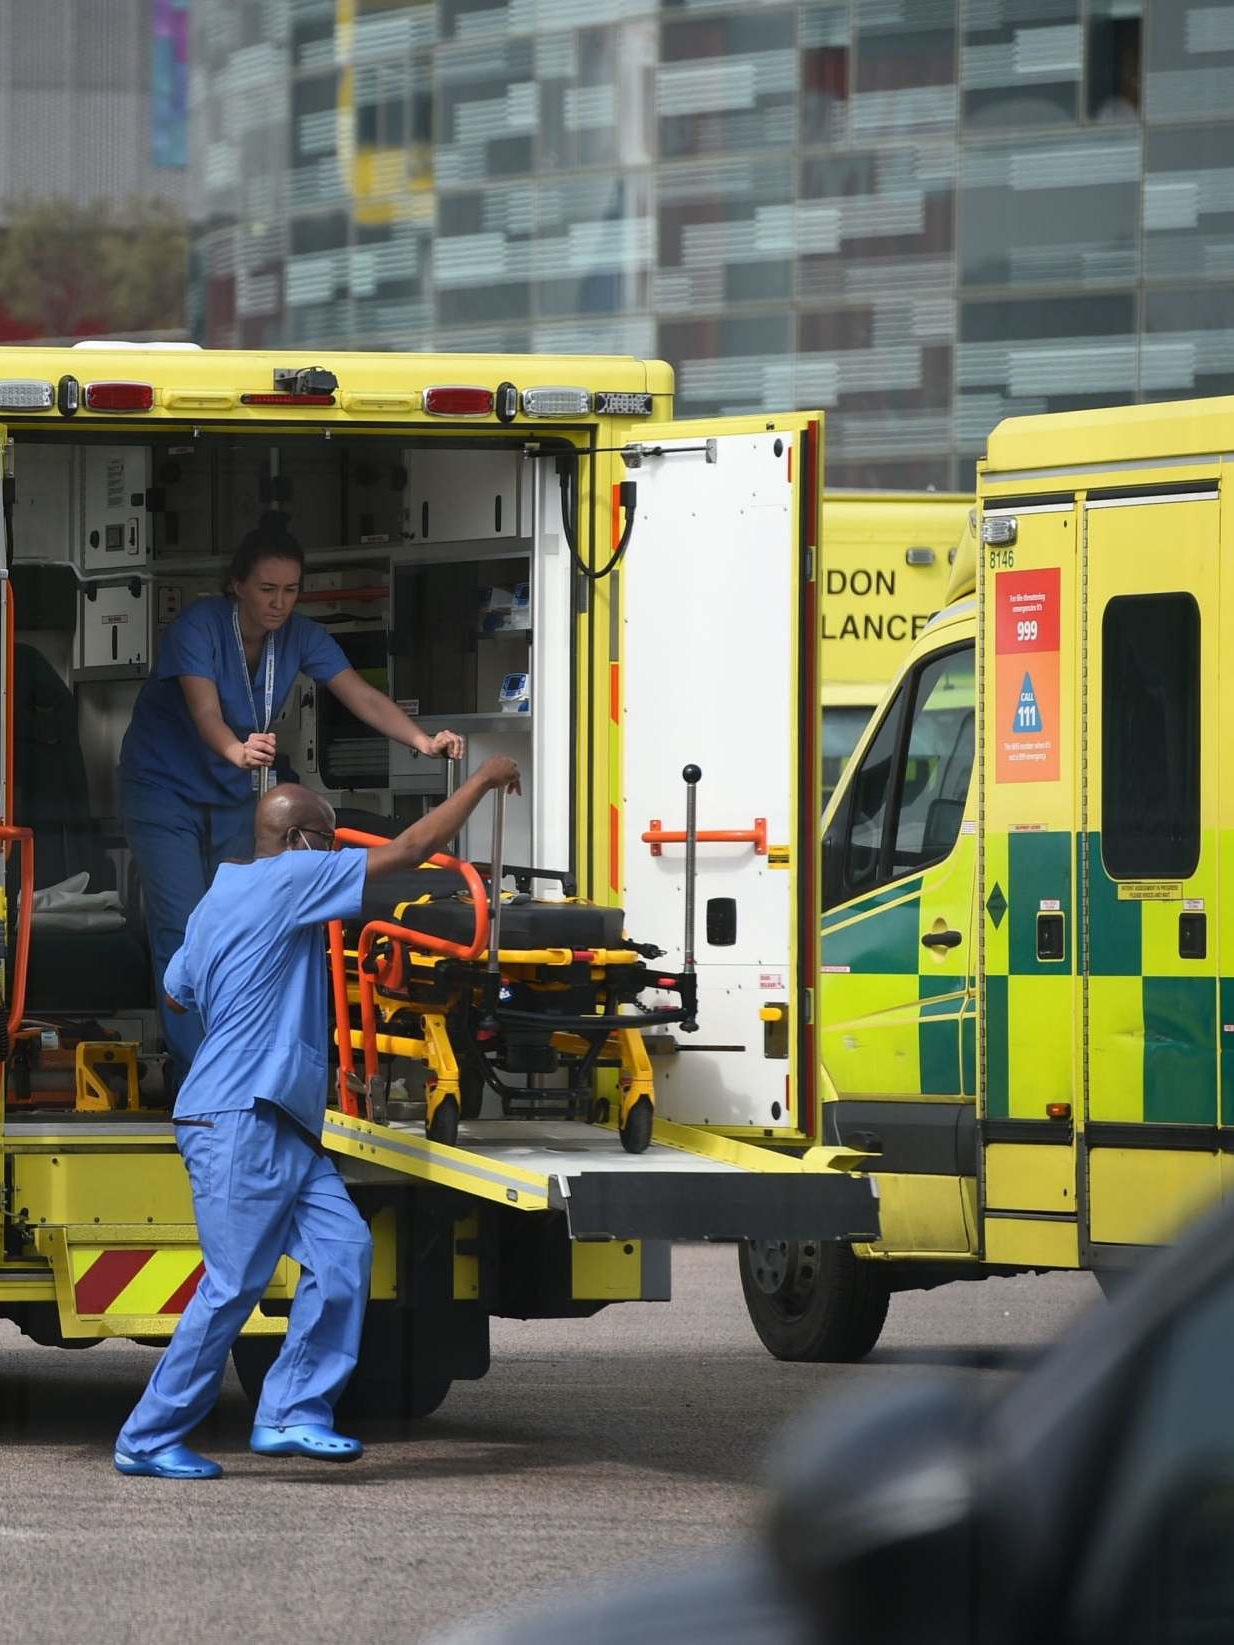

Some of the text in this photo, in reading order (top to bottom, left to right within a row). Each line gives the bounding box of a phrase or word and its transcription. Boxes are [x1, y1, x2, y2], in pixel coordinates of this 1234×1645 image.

[989, 550, 1015, 569] 8146
[821, 570, 895, 596] DON
[1017, 620, 1038, 641] 999
[1020, 692, 1035, 702] CALL
[1018, 705, 1036, 727] 111
